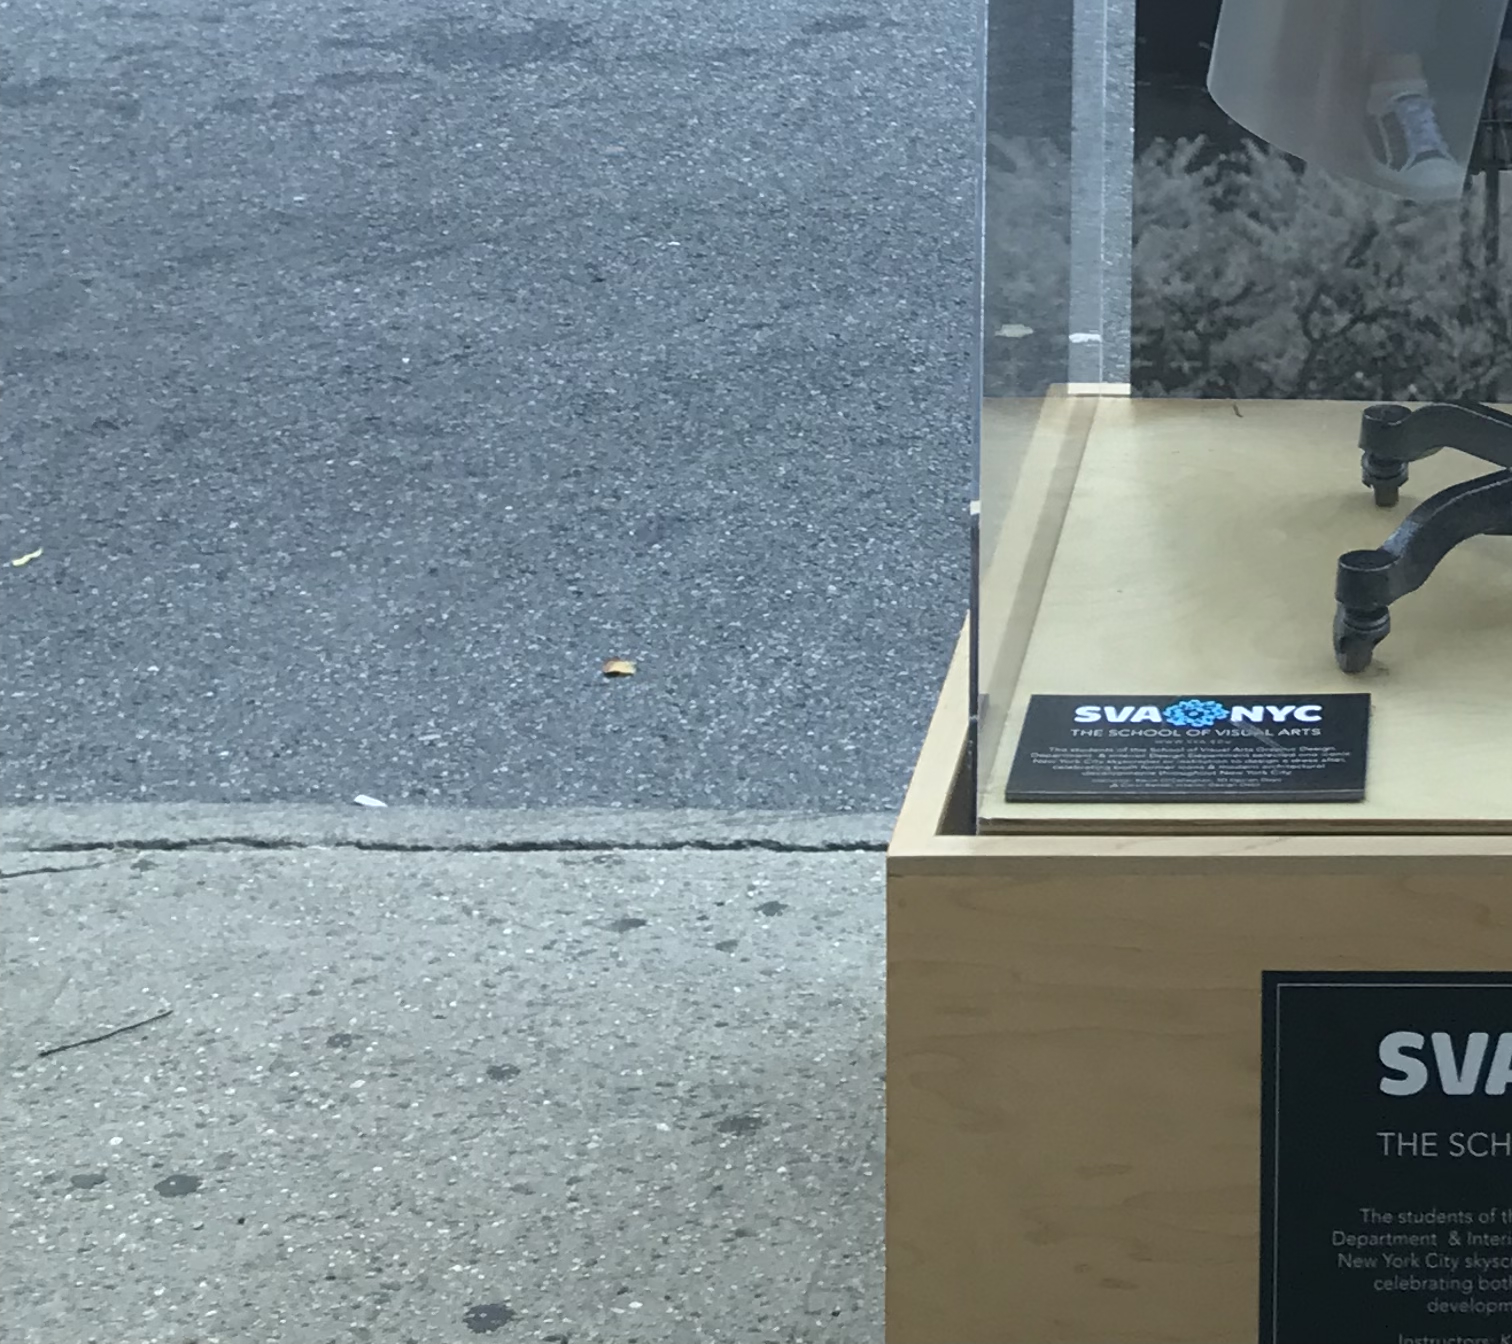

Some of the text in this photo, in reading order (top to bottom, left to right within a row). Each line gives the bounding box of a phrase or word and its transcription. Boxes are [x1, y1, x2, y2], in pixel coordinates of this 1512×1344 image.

[1074, 705, 1323, 723] SVA NYC
[1070, 728, 1103, 736] THE
[1108, 728, 1181, 737] SCHOOL
[1185, 728, 1211, 736] OF
[1277, 728, 1322, 736] ARTS
[1376, 1132, 1438, 1156] THE
[1358, 1207, 1393, 1223] The
[1397, 1208, 1474, 1224] students
[1477, 1207, 1497, 1223] of
[1331, 1230, 1437, 1248] Department
[1447, 1230, 1461, 1246] &
[1337, 1252, 1378, 1268] New
[1381, 1252, 1420, 1268] York
[1424, 1252, 1459, 1272] City
[1373, 1275, 1474, 1295] celebrating
